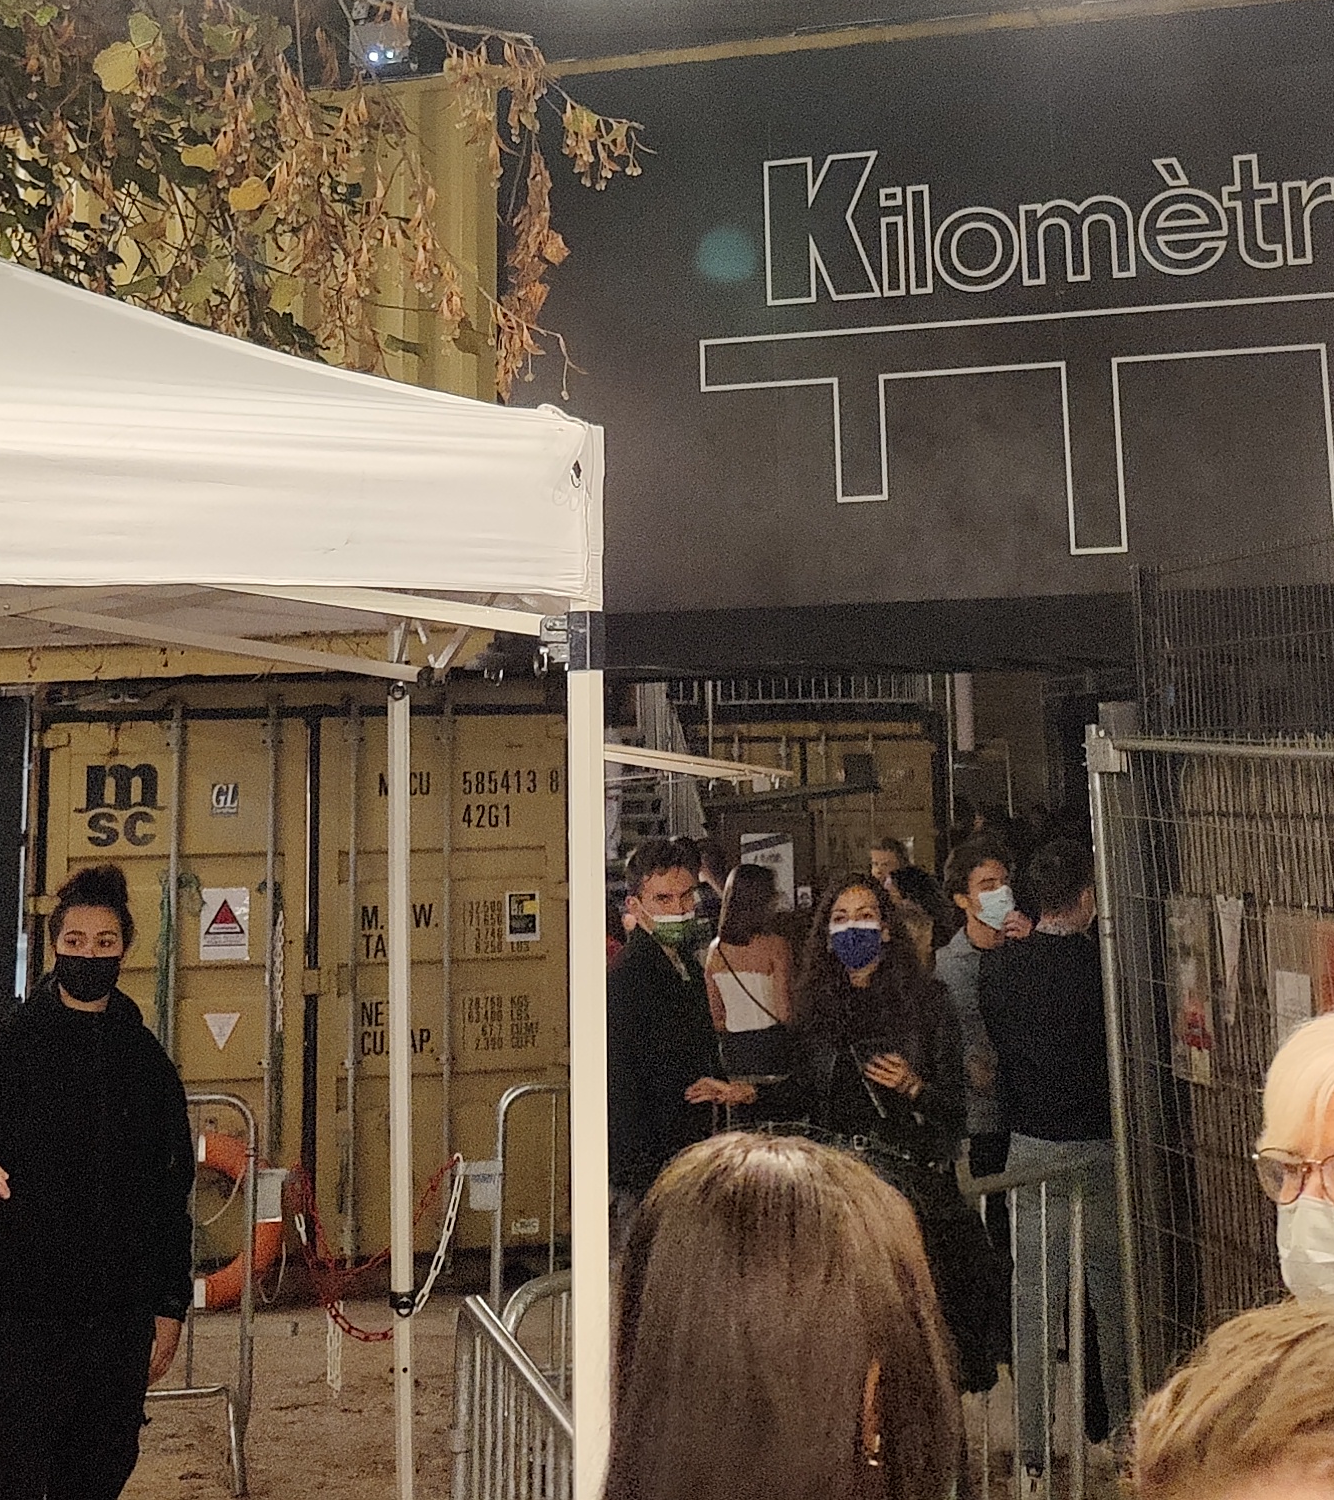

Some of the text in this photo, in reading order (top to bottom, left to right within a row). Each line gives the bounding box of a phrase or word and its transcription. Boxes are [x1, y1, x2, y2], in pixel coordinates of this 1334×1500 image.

[212, 783, 238, 808] GL
[378, 769, 559, 798] MCU 585413 8
[462, 804, 511, 828] 42G1
[361, 1001, 390, 1027] NE
